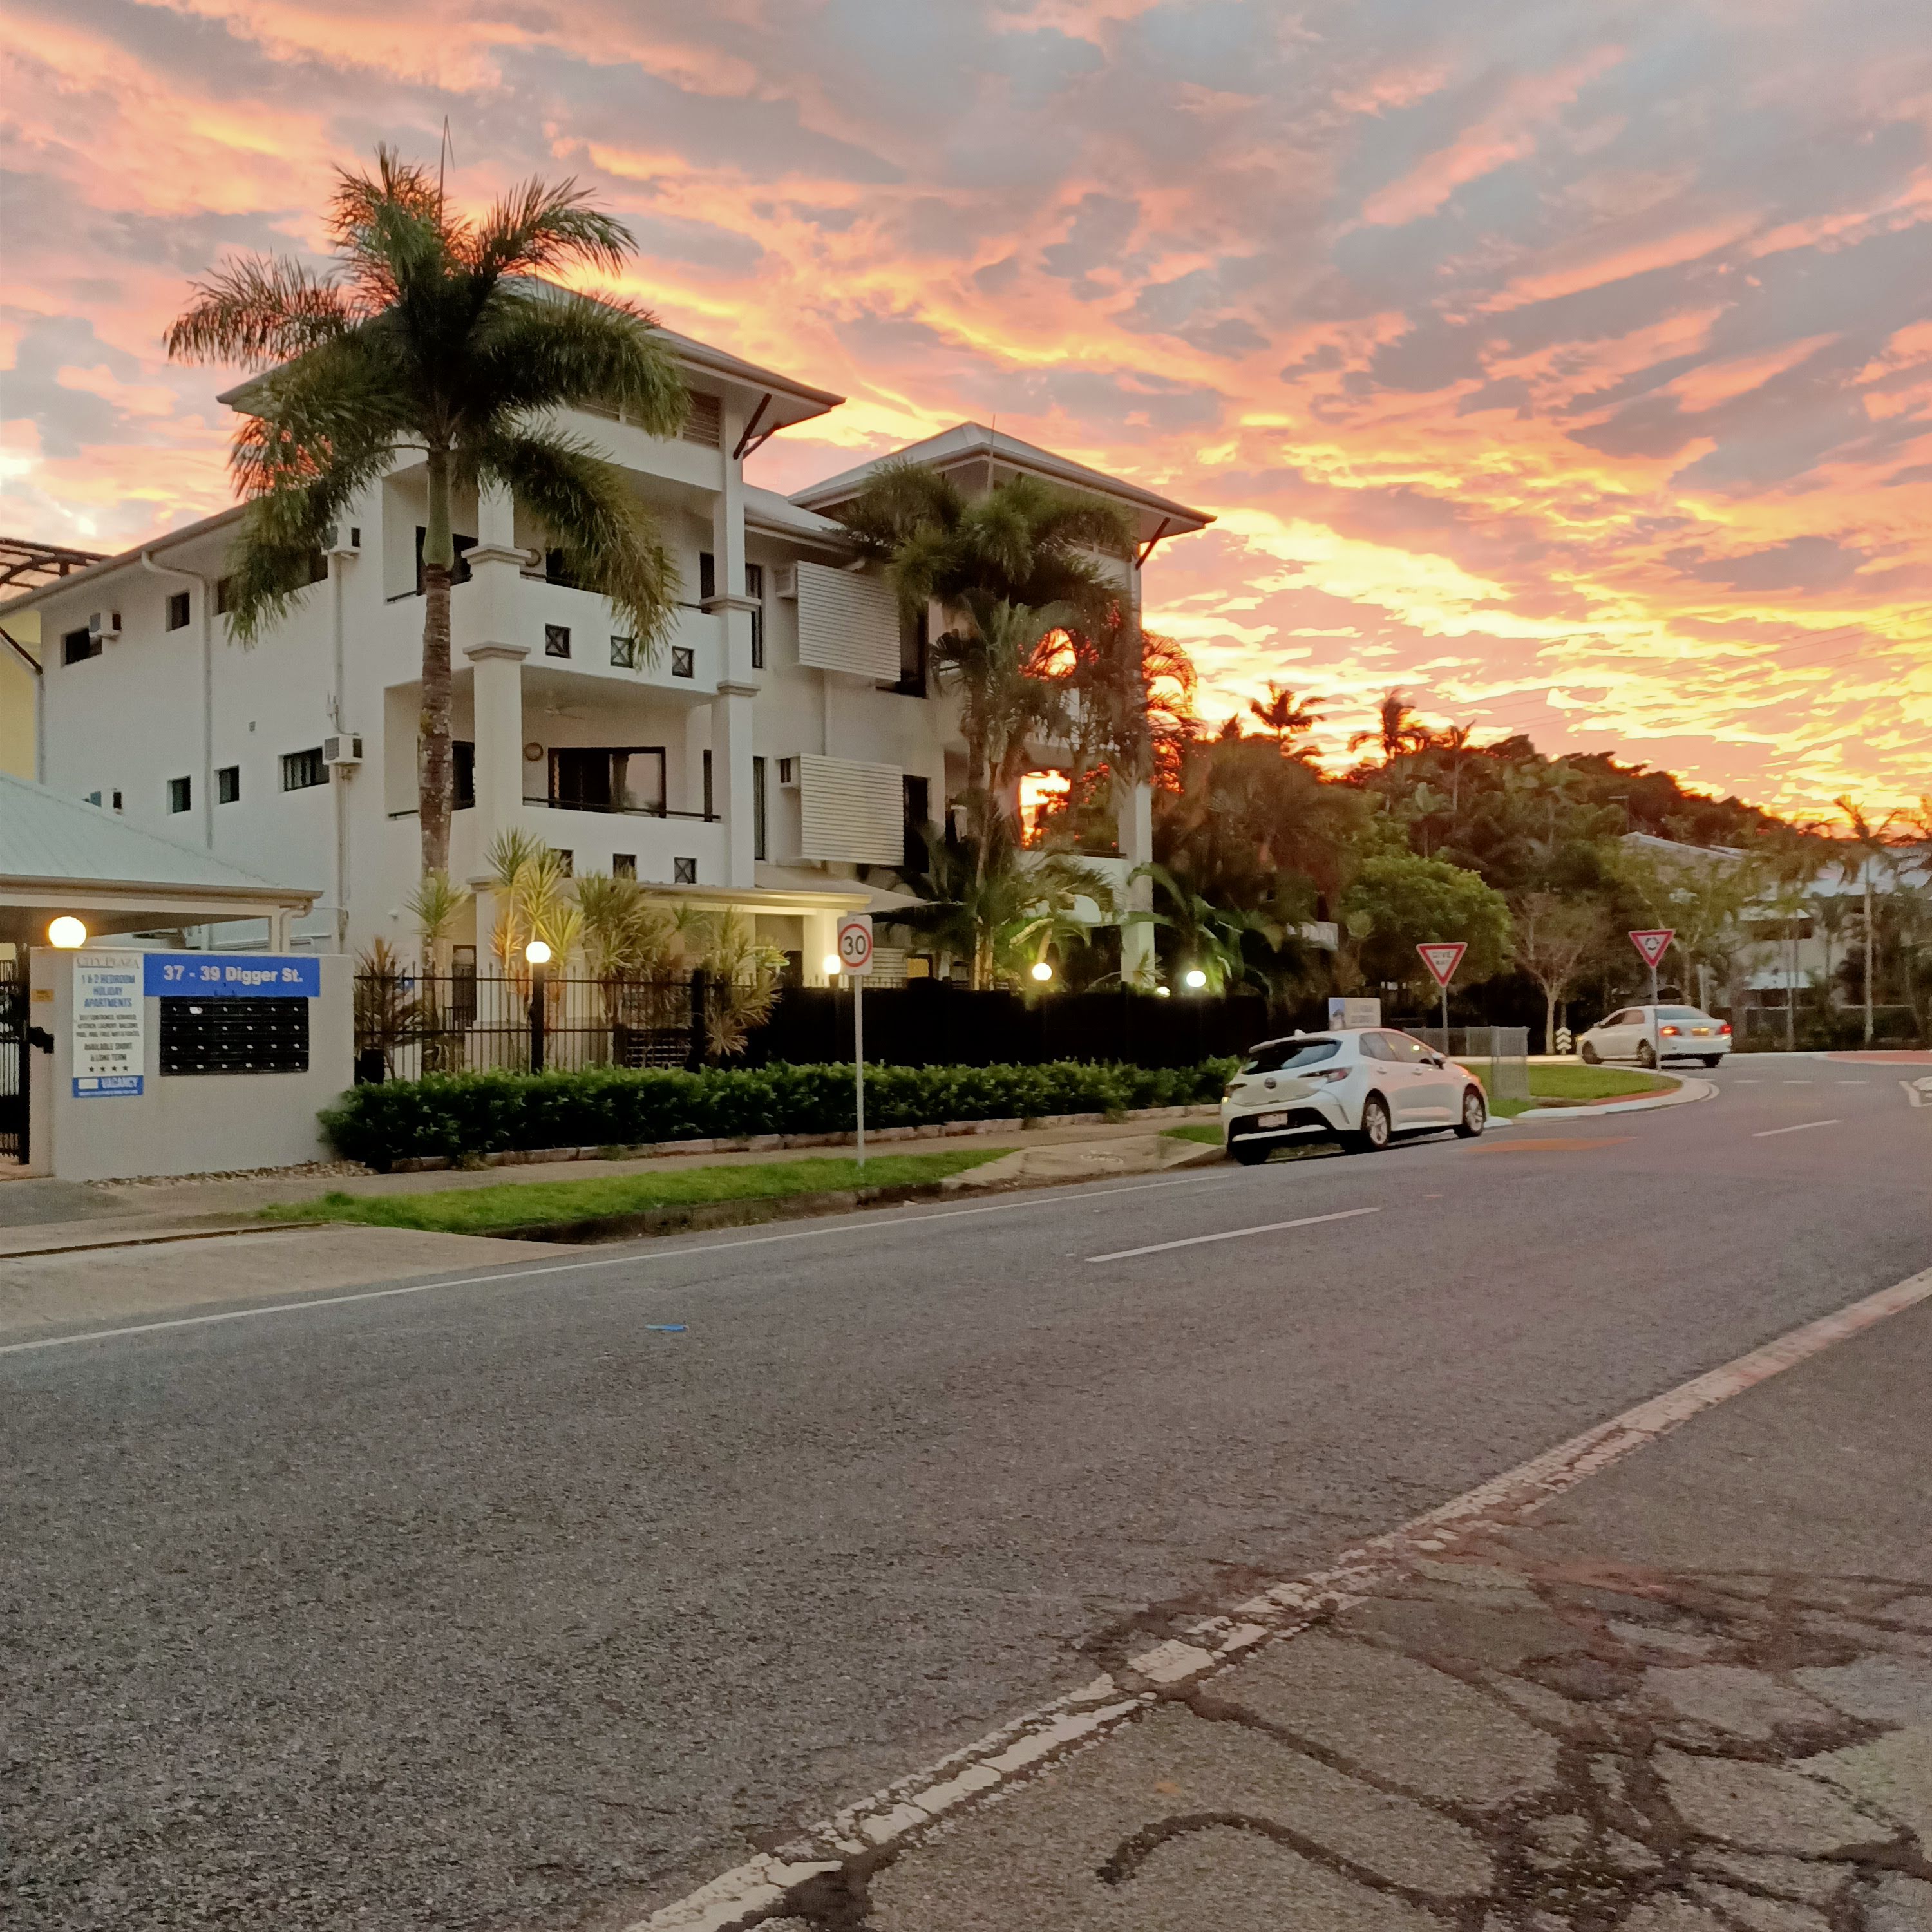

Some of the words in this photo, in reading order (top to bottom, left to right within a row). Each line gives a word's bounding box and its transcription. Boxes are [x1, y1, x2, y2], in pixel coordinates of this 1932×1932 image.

[843, 935, 866, 956] 30
[163, 965, 185, 981] 37
[200, 965, 221, 981] 39
[225, 966, 278, 985] Digger
[281, 967, 304, 983] St.
[84, 998, 132, 1007] APARTMENTS
